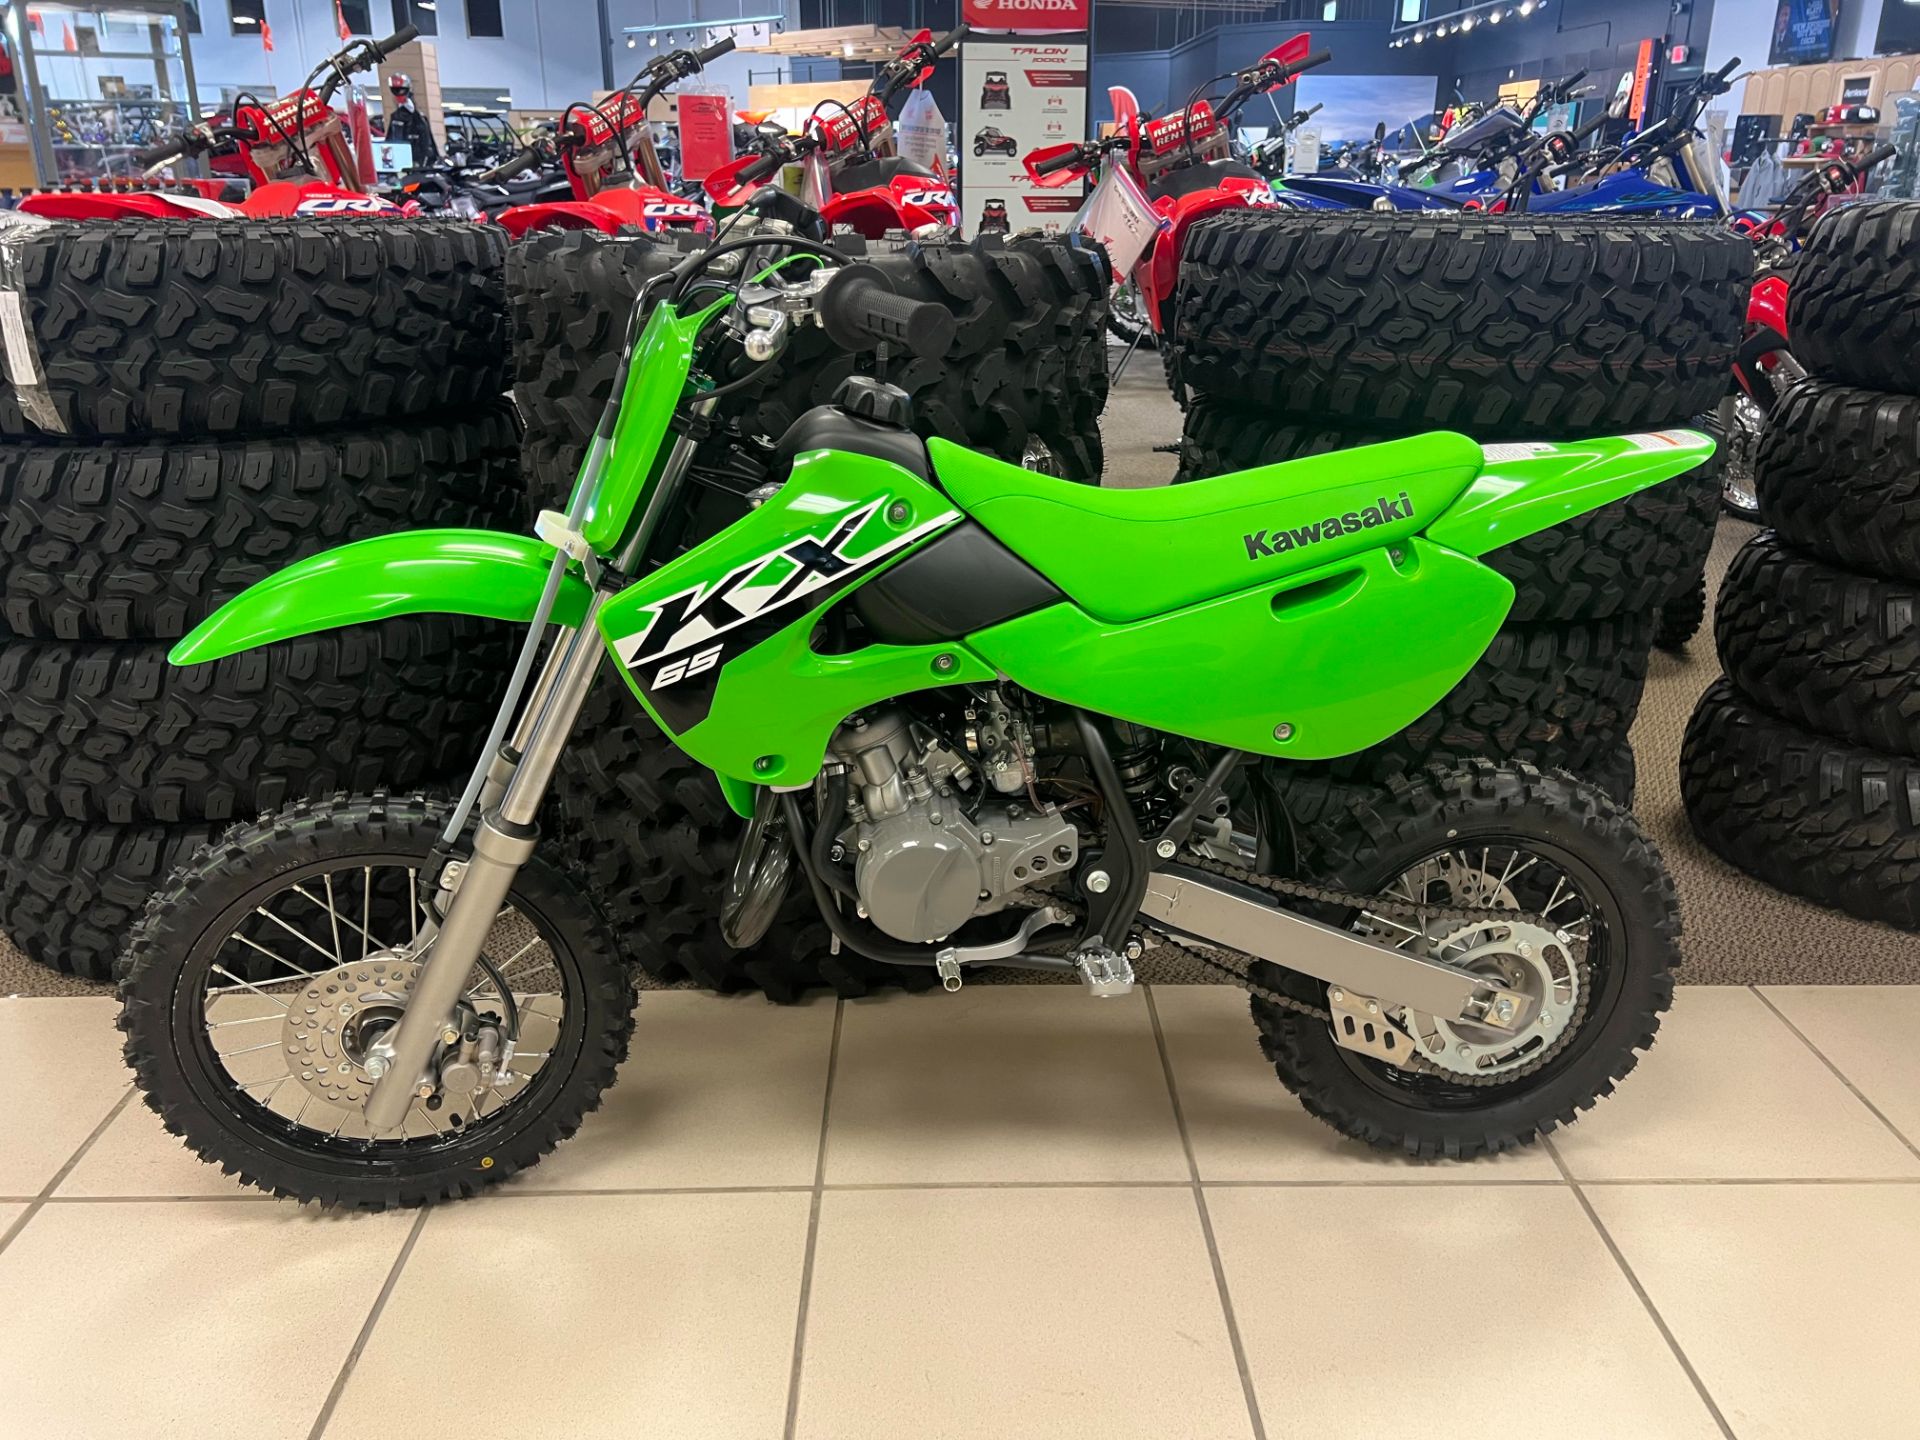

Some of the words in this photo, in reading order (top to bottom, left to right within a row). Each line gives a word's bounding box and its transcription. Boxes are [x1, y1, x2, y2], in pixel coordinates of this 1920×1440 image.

[997, 0, 1078, 10] HONDA
[269, 105, 320, 134] RNTAL
[839, 109, 881, 140] RENTAL
[1153, 111, 1208, 138] RENTAL
[1156, 120, 1210, 147] RENTAL
[1243, 491, 1415, 561] Kawasaki
[627, 494, 888, 667] KX
[651, 644, 724, 691] 65
